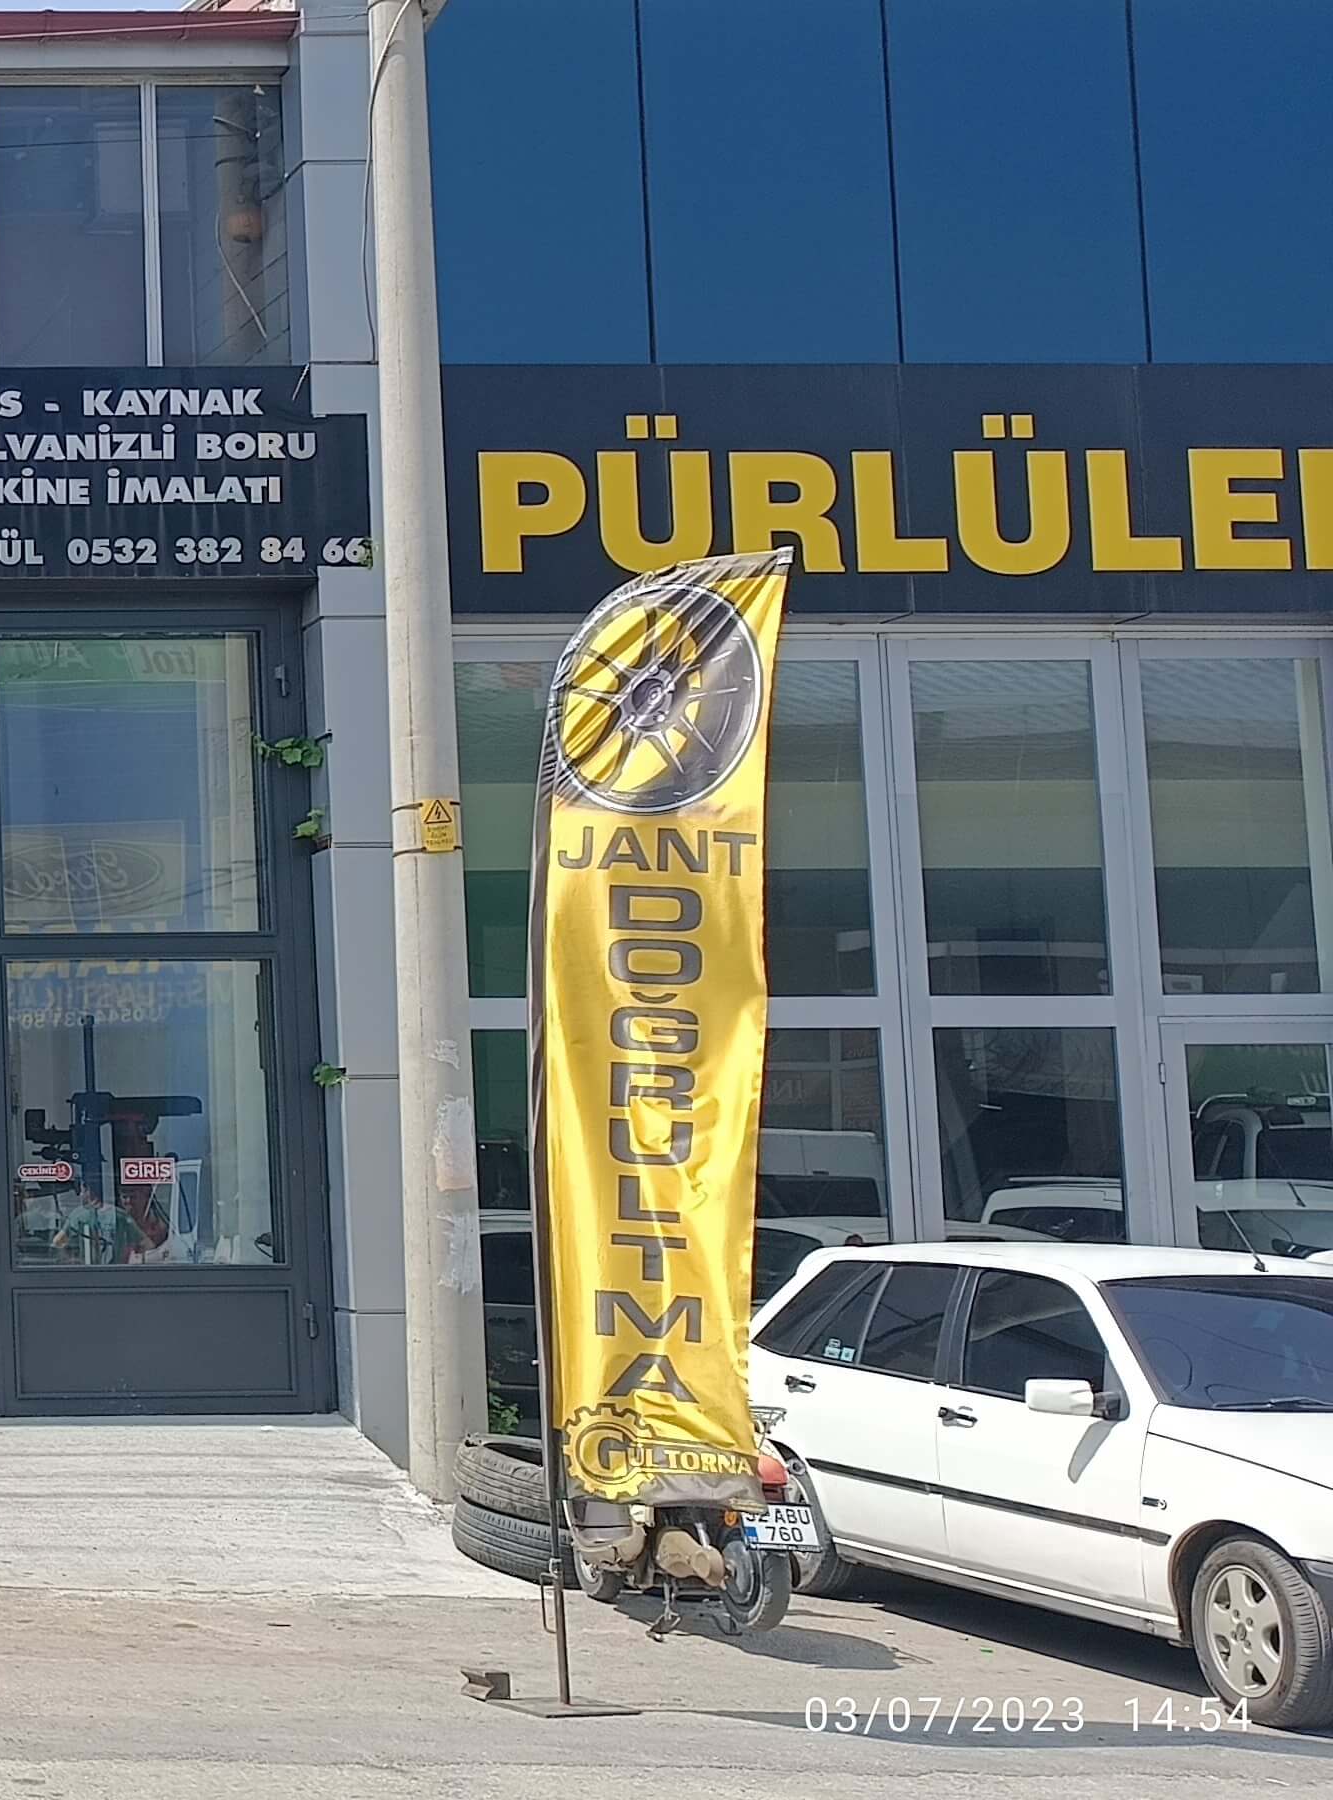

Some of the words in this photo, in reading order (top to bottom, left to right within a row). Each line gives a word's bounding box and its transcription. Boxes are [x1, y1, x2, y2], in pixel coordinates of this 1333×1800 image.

[82, 388, 263, 417] KAYNAK
[196, 432, 318, 461] BORU
[107, 468, 282, 504] İMALATI
[67, 537, 158, 566] 0532
[175, 537, 242, 564] 382
[260, 537, 306, 564] 84
[322, 537, 367, 564] 66
[557, 825, 758, 877] JANT
[594, 884, 703, 1403] DOĞRULTMA
[124, 1161, 172, 1182] GİRİŞ
[579, 1428, 661, 1478] GÜL
[663, 1449, 755, 1477] TORNA
[774, 1507, 811, 1525] ABU
[764, 1526, 804, 1543] 760
